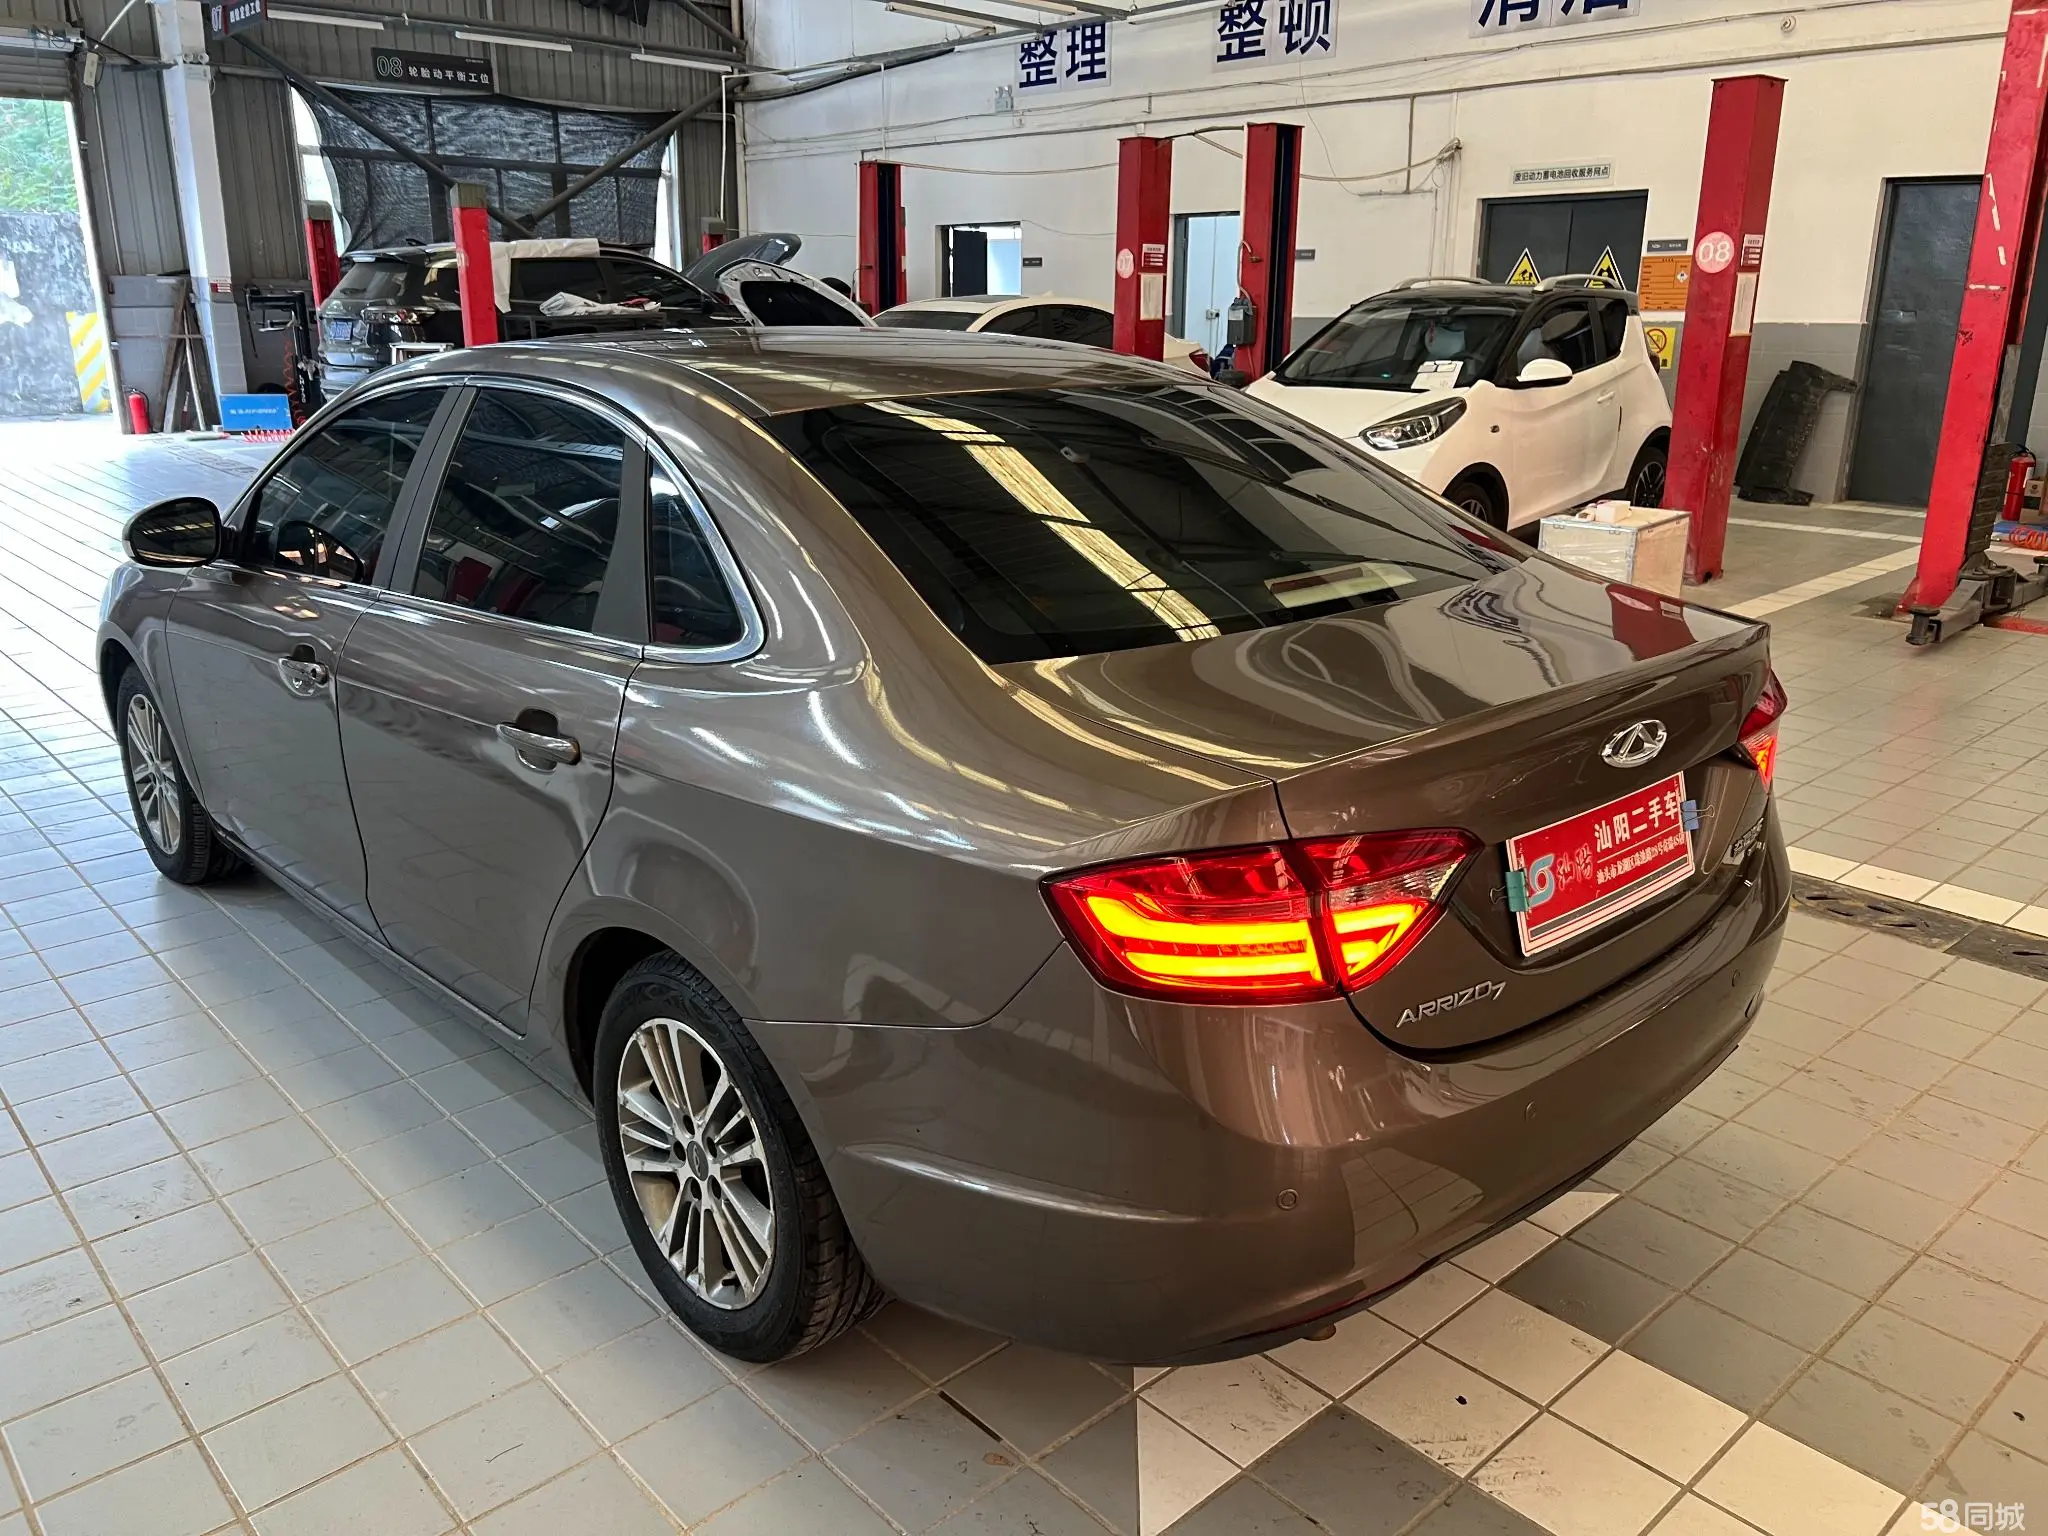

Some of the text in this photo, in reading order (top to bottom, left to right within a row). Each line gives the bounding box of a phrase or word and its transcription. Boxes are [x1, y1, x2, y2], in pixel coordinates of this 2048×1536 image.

[1018, 20, 1108, 89] 整理
[1216, 0, 1331, 63] 整顿
[376, 55, 490, 84] 08 轮胎动平衡工位
[1698, 240, 1731, 264] 08
[1594, 790, 1679, 853] 汕阳二手车
